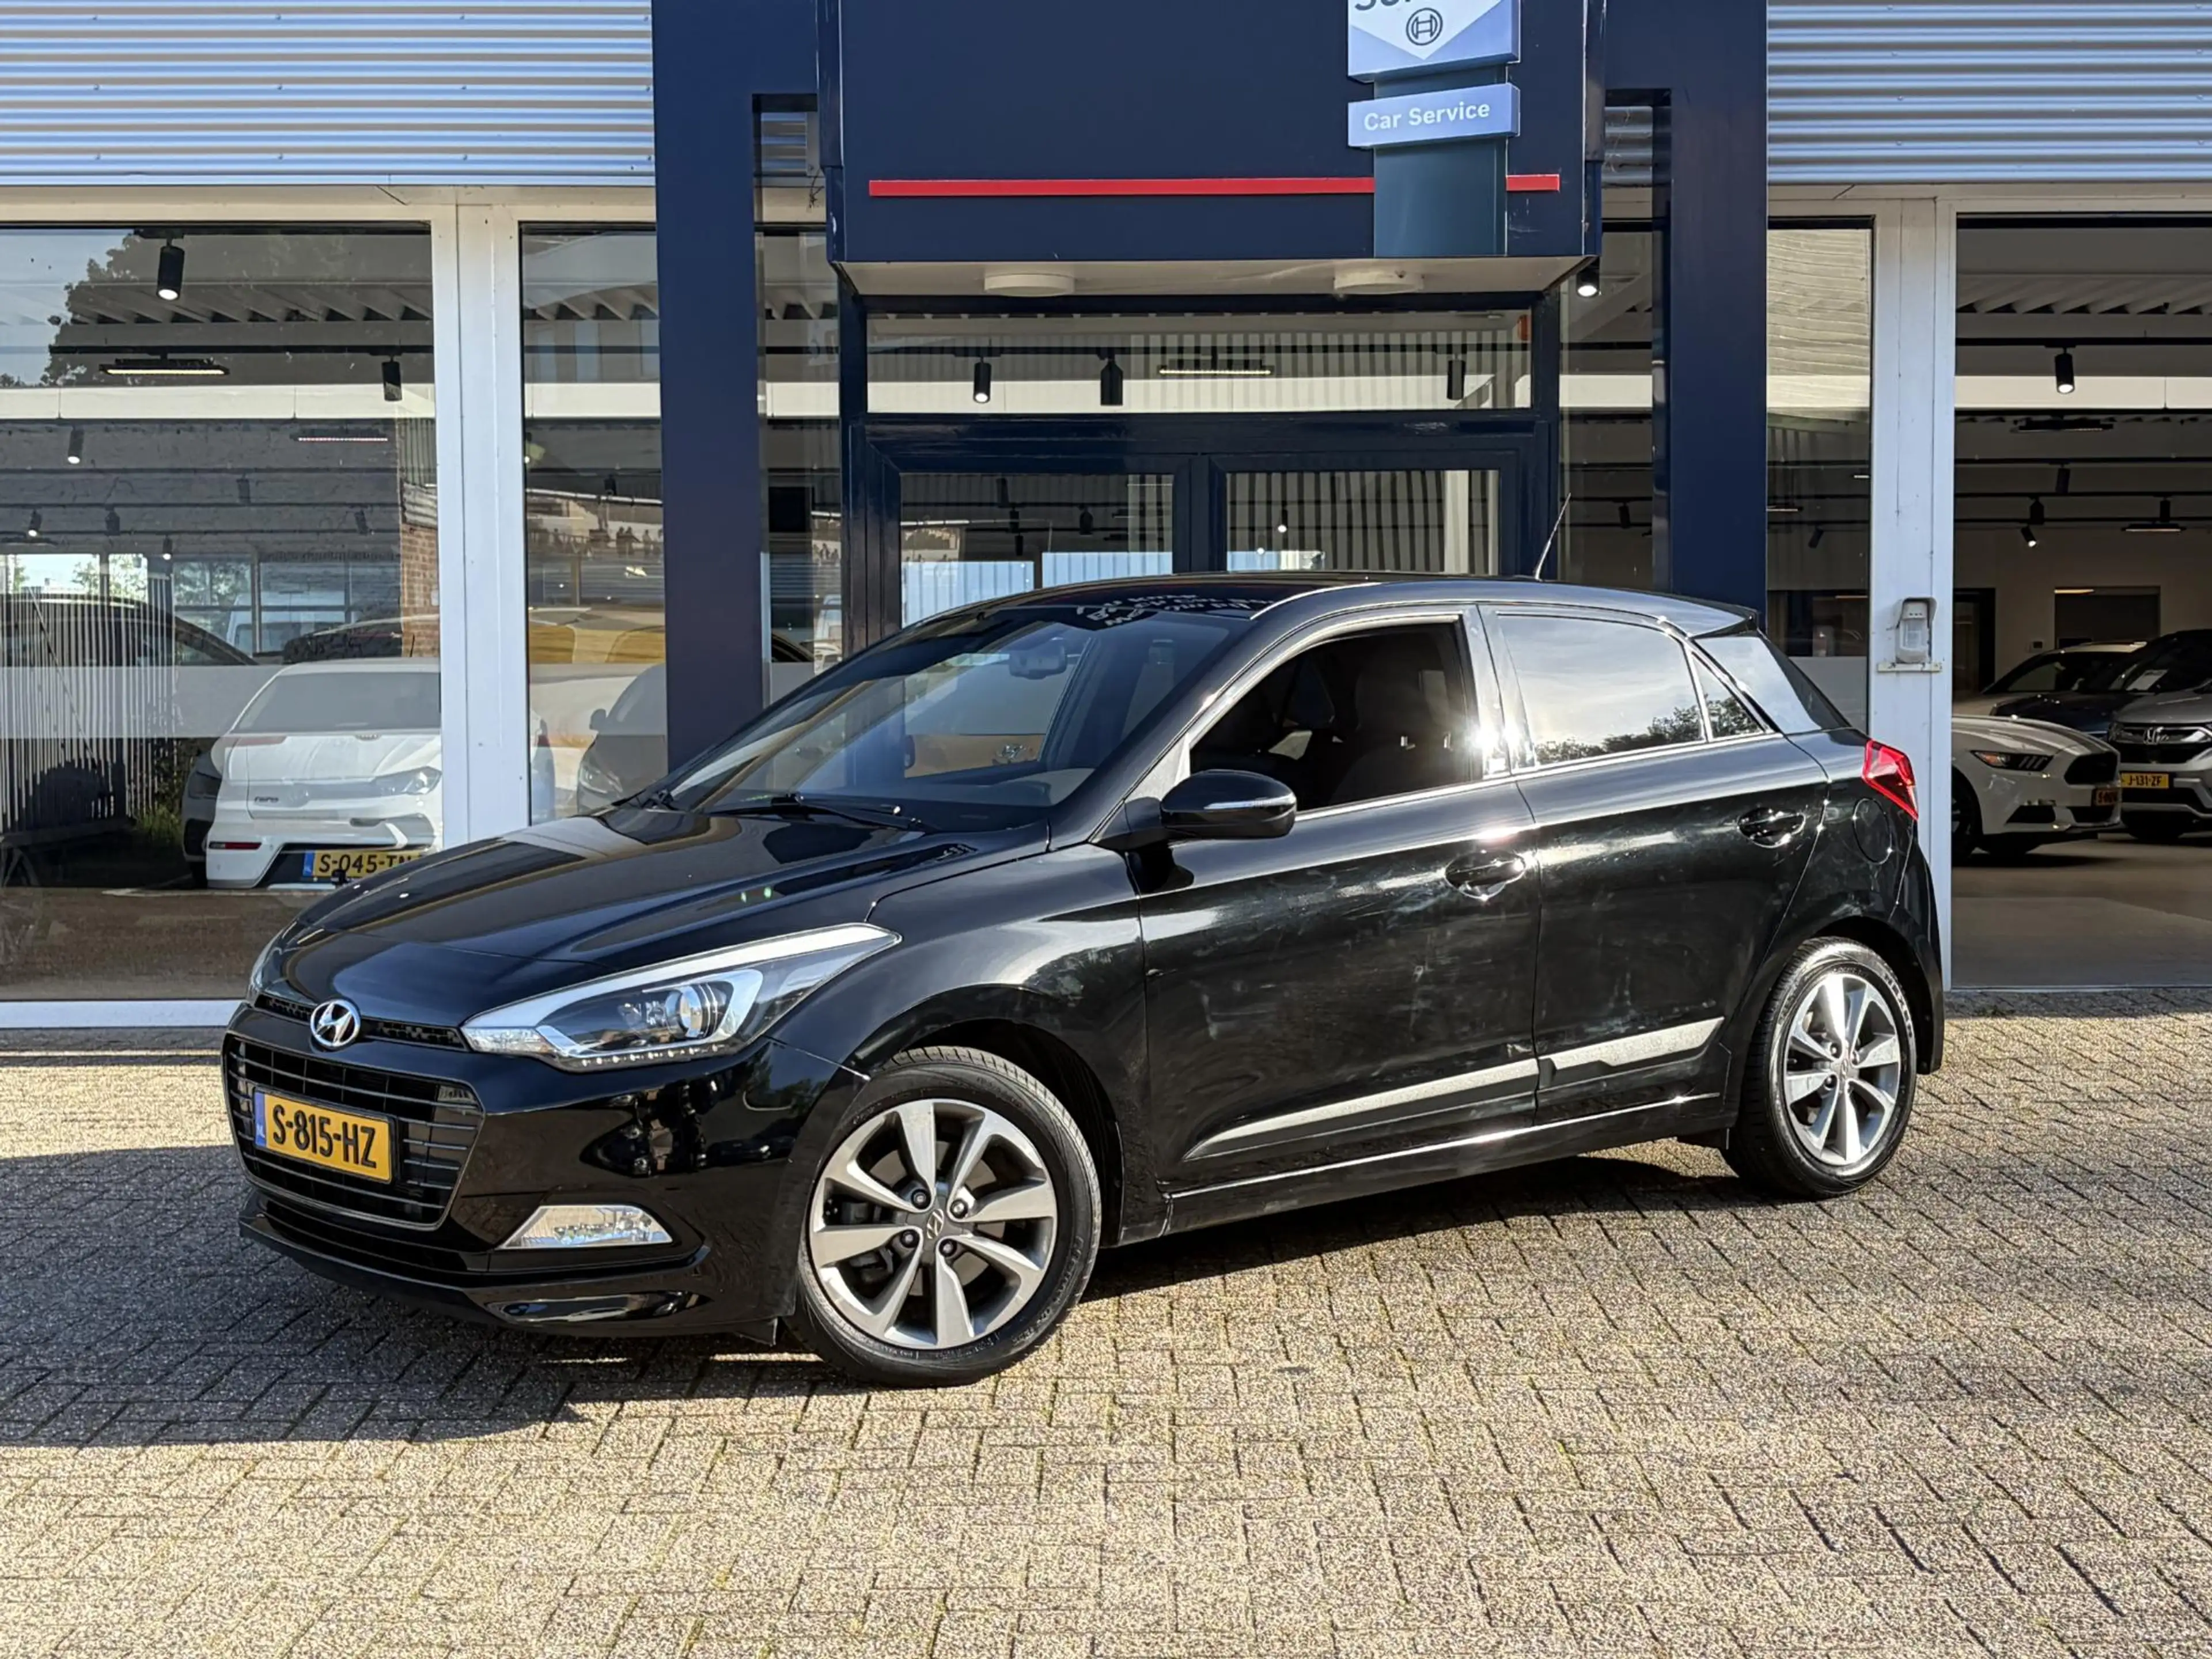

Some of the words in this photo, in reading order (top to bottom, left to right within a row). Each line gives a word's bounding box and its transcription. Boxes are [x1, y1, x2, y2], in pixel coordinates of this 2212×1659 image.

[1364, 113, 1402, 131] Car
[1409, 102, 1491, 126] Service
[273, 1104, 377, 1168] S-815-HZ
